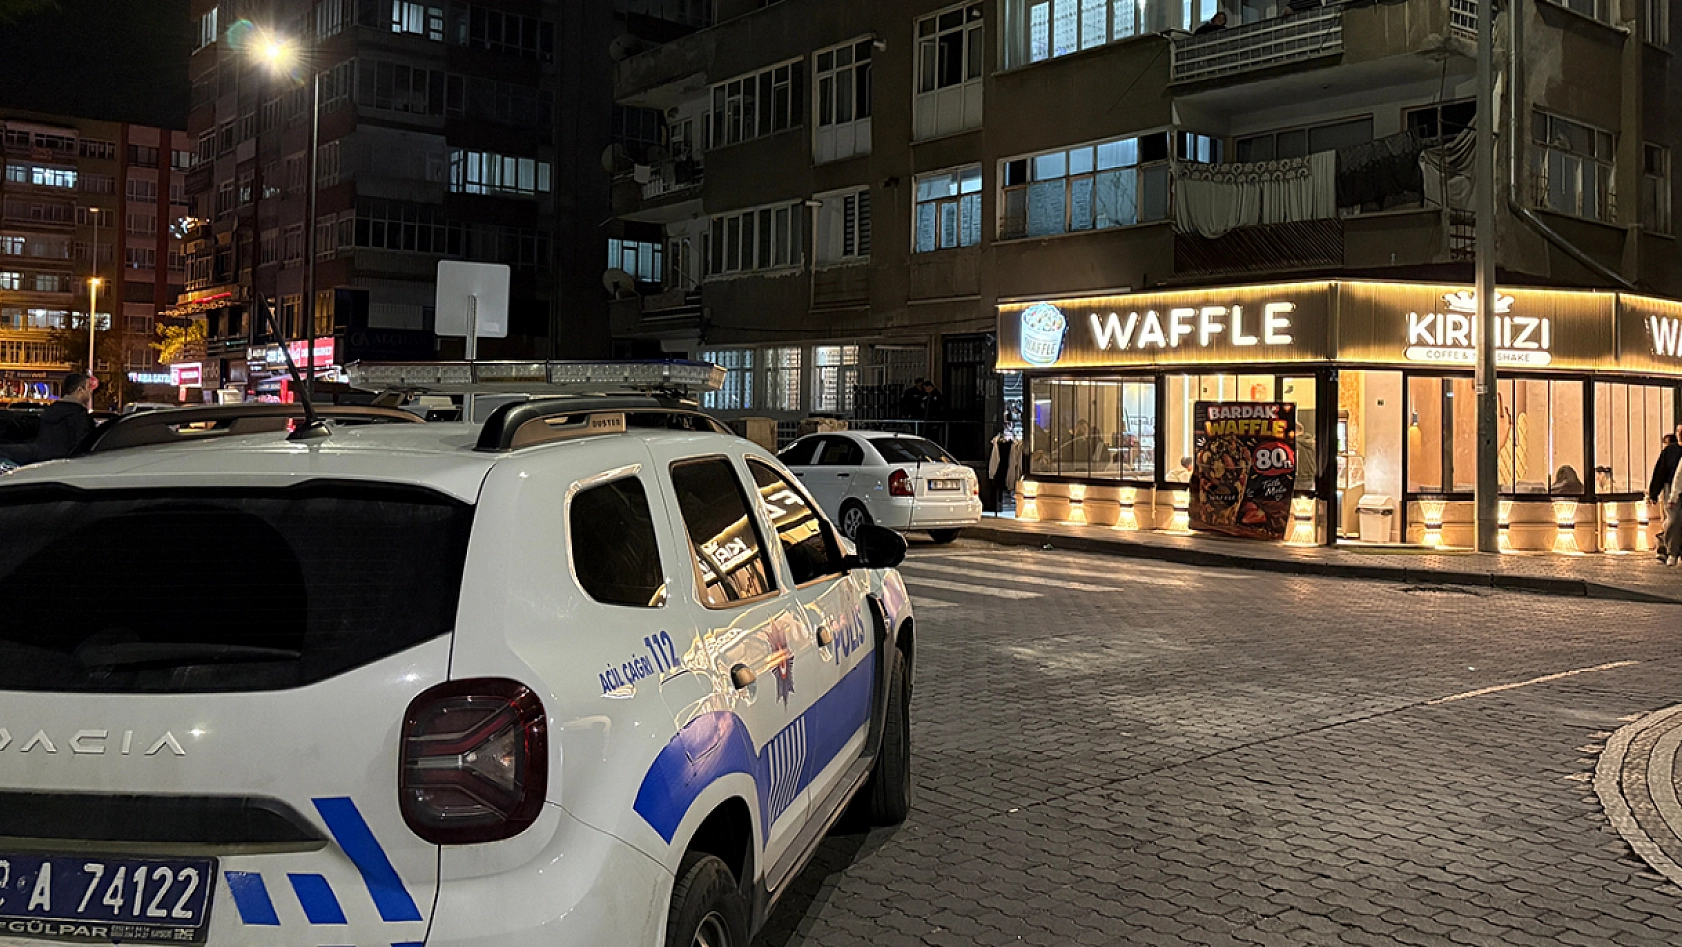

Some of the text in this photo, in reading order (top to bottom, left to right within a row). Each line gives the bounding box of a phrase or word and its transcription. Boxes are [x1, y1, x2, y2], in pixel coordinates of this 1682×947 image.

[1090, 302, 1293, 350] WAFFLE
[1025, 336, 1056, 355] WAFFLE
[1426, 349, 1459, 360] COFFE
[1462, 351, 1468, 359] &
[1208, 405, 1279, 420] BARDAK
[593, 418, 620, 428] DUSTER
[1205, 420, 1287, 438] WAFFLE
[599, 663, 625, 693] ACİL
[643, 630, 681, 673] 112
[28, 862, 51, 912] A
[77, 863, 200, 919] 74122
[9, 921, 109, 938] GÜLPAR
